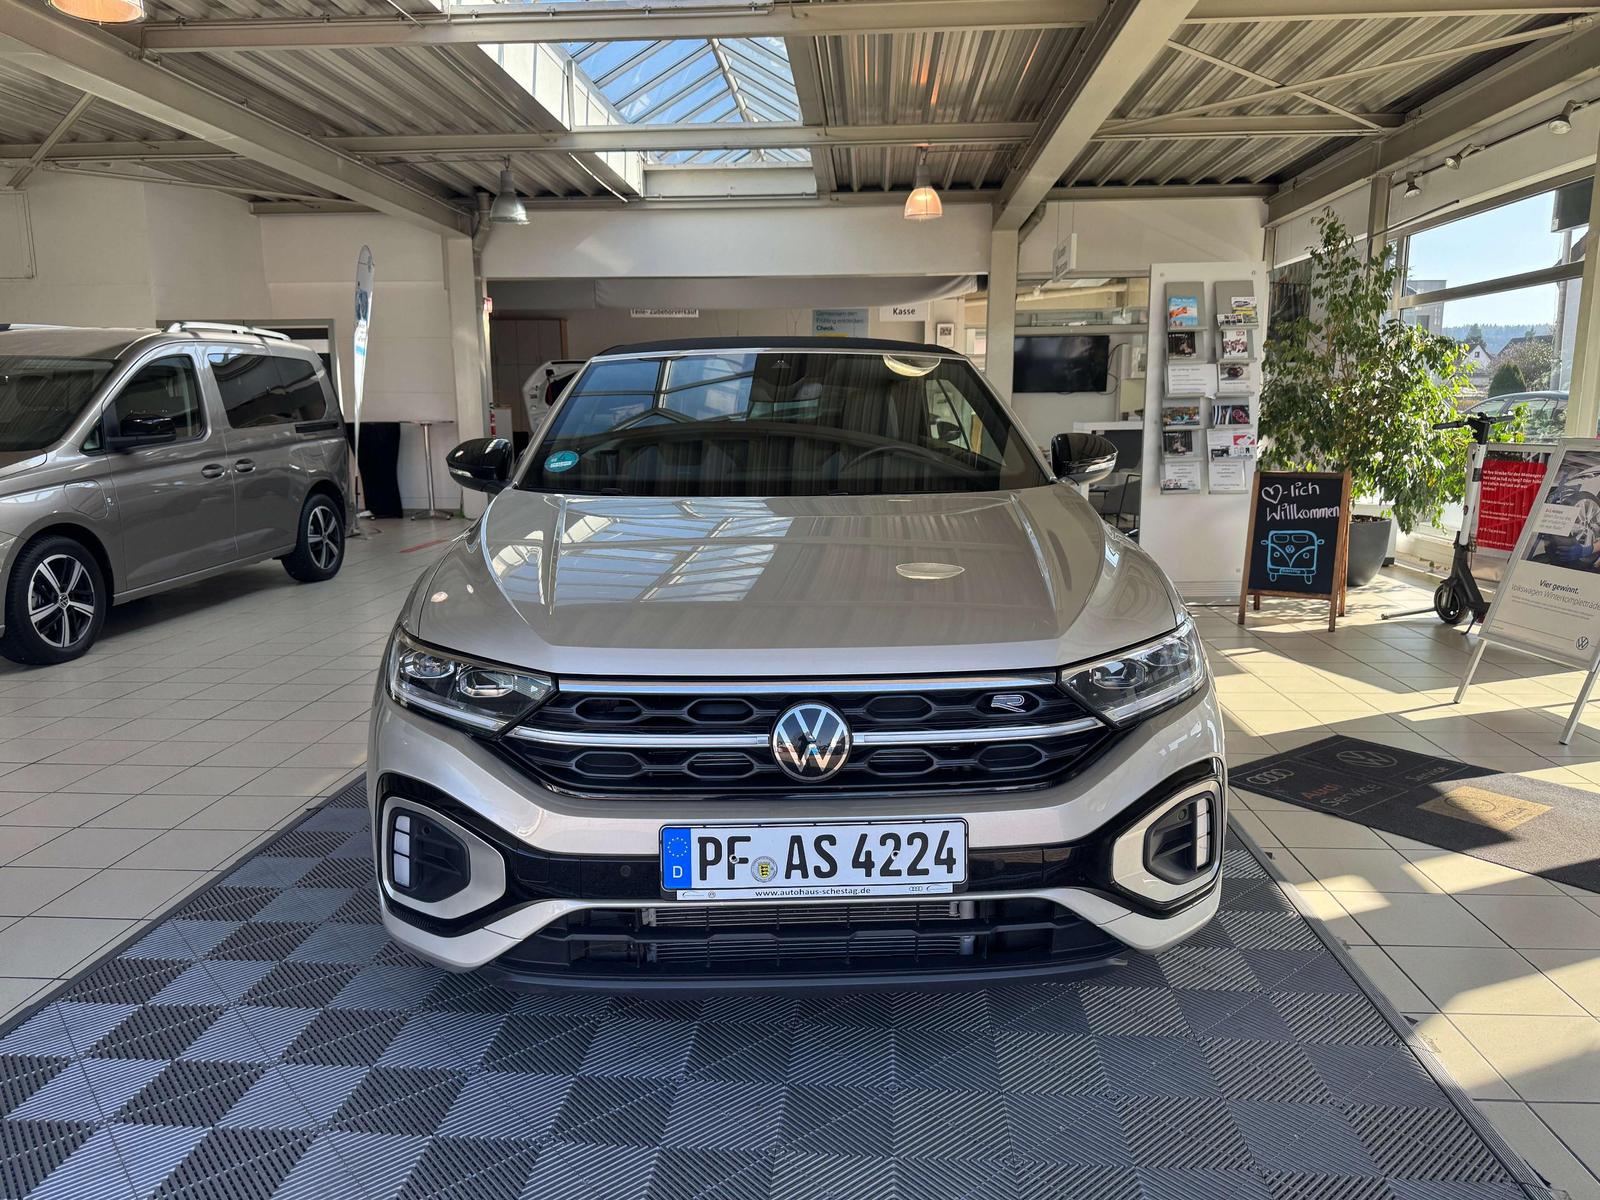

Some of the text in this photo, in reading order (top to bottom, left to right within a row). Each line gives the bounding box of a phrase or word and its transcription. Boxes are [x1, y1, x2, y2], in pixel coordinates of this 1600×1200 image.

[892, 307, 916, 316] Kasse
[1266, 503, 1340, 521] Willkommen
[1540, 579, 1579, 594] Vier gewinnt.
[1404, 765, 1449, 782] Service
[1302, 783, 1340, 800] Audi
[1319, 782, 1383, 807] Service
[697, 830, 957, 881] PF AS 4224
[672, 865, 683, 878] D
[755, 887, 871, 897] www.autohaus-schestag.de
